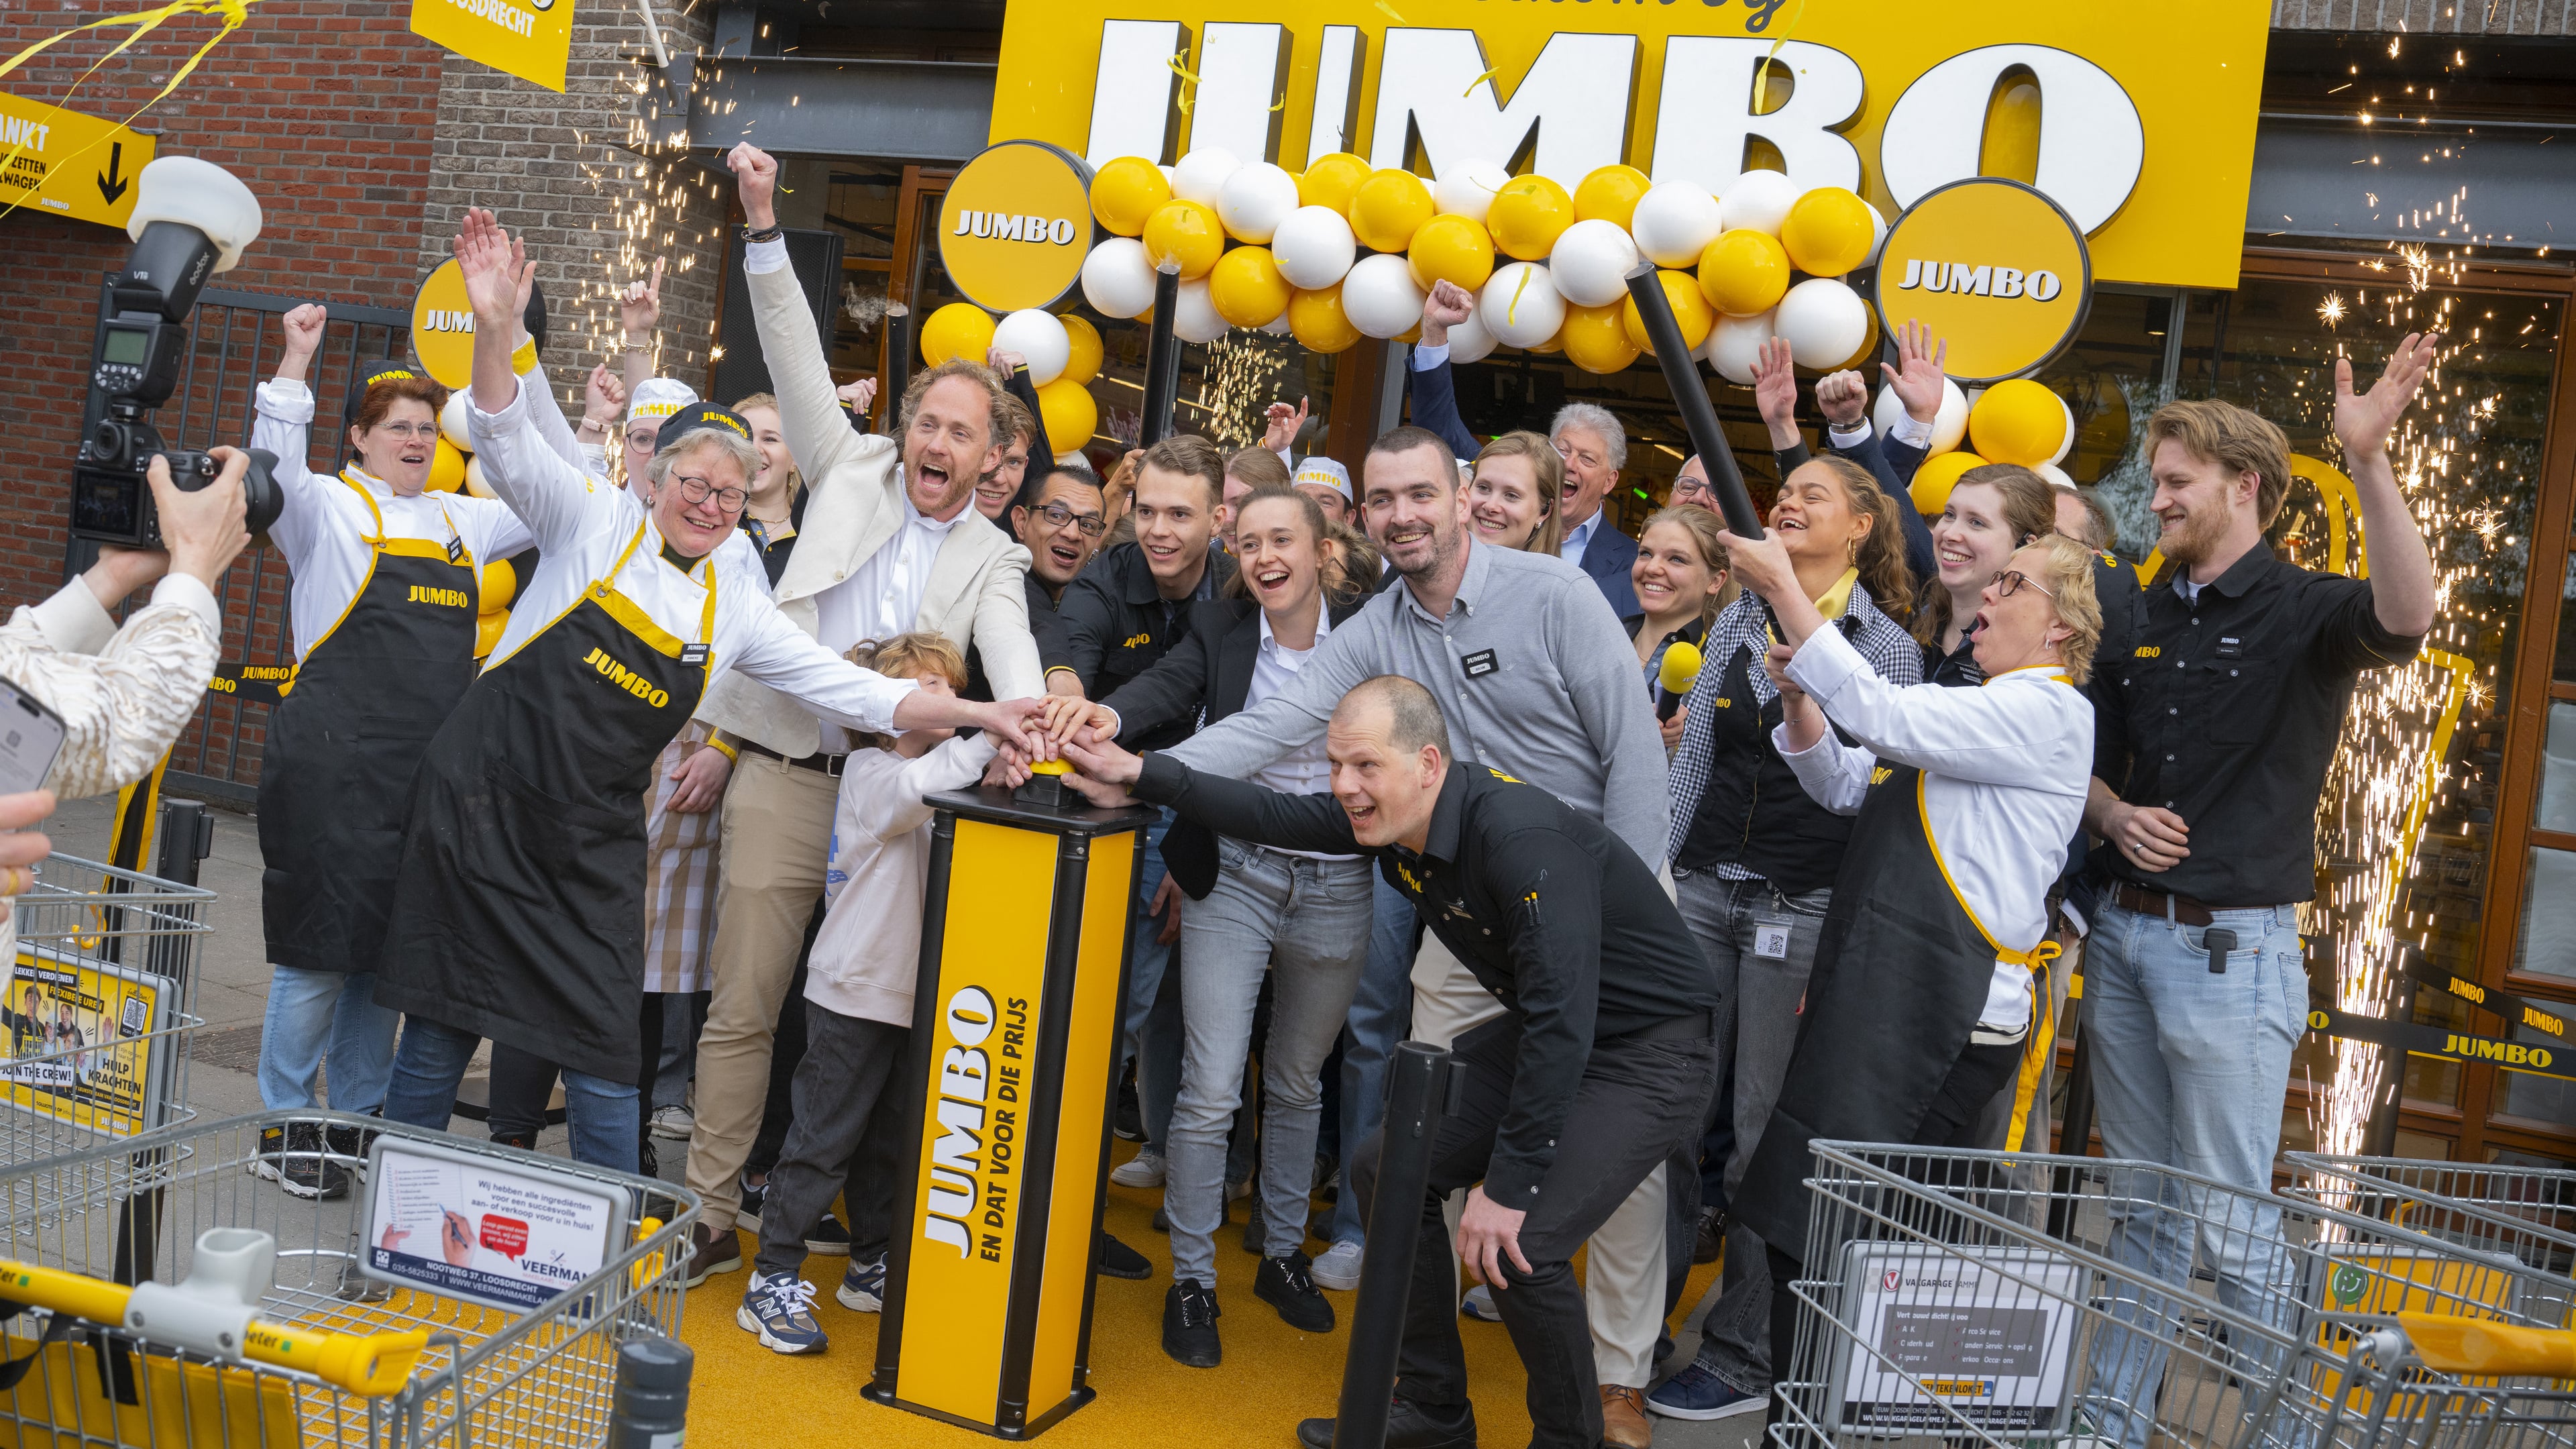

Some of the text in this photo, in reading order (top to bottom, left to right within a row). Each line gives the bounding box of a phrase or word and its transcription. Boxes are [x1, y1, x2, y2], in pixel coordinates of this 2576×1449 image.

[1085, 18, 2145, 236] JUMBO
[40, 197, 70, 211] JUMBO
[953, 210, 1075, 246] JUMBO
[189, 252, 210, 285] Godox
[1898, 259, 2062, 302] JUMBO
[423, 310, 476, 333] JUM
[701, 411, 748, 439] JUMBO
[1297, 472, 1340, 487] JUMBO
[407, 585, 468, 608] JUMBO
[241, 666, 289, 680] JUMBO
[1466, 653, 1491, 664] JUMBO
[583, 647, 669, 708] JUMBO
[2449, 977, 2484, 1004] JUMBO
[2522, 1007, 2563, 1036] JUMBO
[2442, 1034, 2552, 1068] JUMBO
[924, 985, 997, 1259] JUMBO
[980, 998, 1028, 1263] EN DAT VOOR DIE PRIJS
[478, 1180, 592, 1211] Wij hebben alle ingrediënten
[491, 1194, 509, 1203] voor
[528, 1202, 576, 1218] succesvolle
[472, 1199, 488, 1208] aan-
[500, 1205, 533, 1218] verkoop
[535, 1214, 553, 1222] voor
[564, 1218, 571, 1226] in
[573, 1221, 594, 1231] huis!
[392, 1264, 438, 1280] 035-5825333
[449, 1276, 549, 1305] WWW.VEERMANMAKELAA
[427, 1262, 539, 1293] NOOTWEG 37, LOOSDRECHT
[521, 1259, 590, 1283] VEERMAN
[757, 1297, 782, 1320] N
